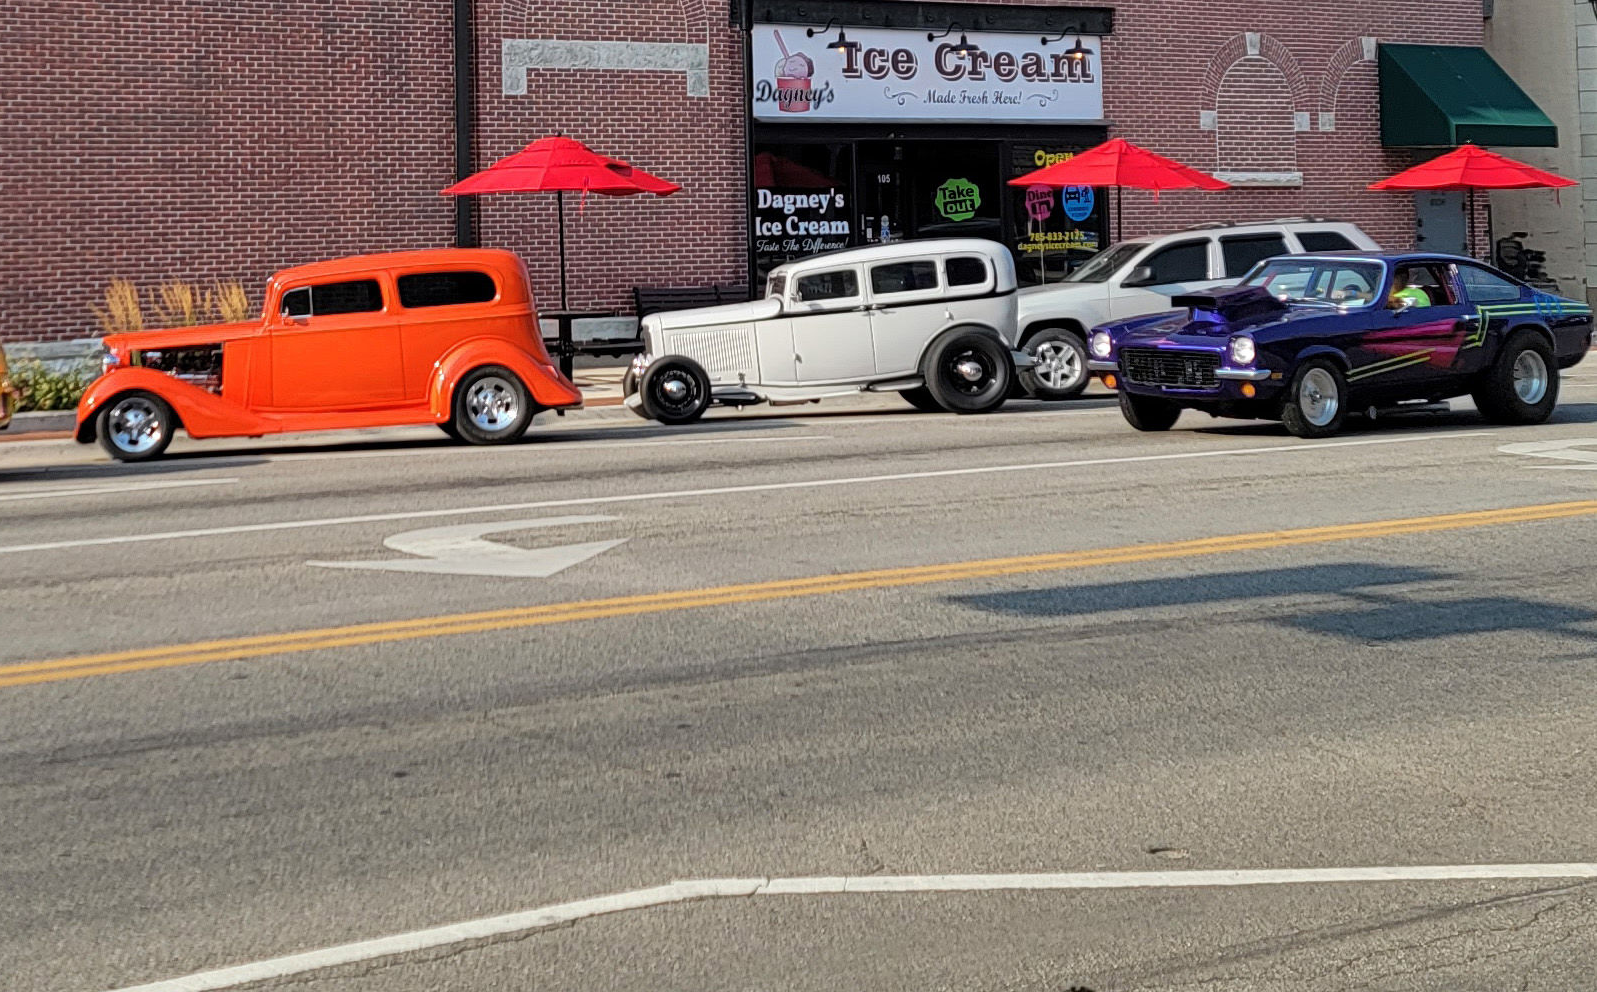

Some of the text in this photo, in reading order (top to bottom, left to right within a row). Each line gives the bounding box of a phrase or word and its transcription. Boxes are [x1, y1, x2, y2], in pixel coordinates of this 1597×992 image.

[839, 41, 1095, 83] Ice Cream
[755, 79, 835, 110] Dagney's
[923, 89, 1022, 105] Made Fresh Here!
[877, 174, 891, 183] 105
[939, 185, 975, 200] Take
[1027, 190, 1053, 201] Dine
[757, 188, 844, 214] Dagney's
[946, 199, 973, 213] out
[755, 216, 850, 236] Ice Cream
[756, 236, 849, 253] Taste The Difference!
